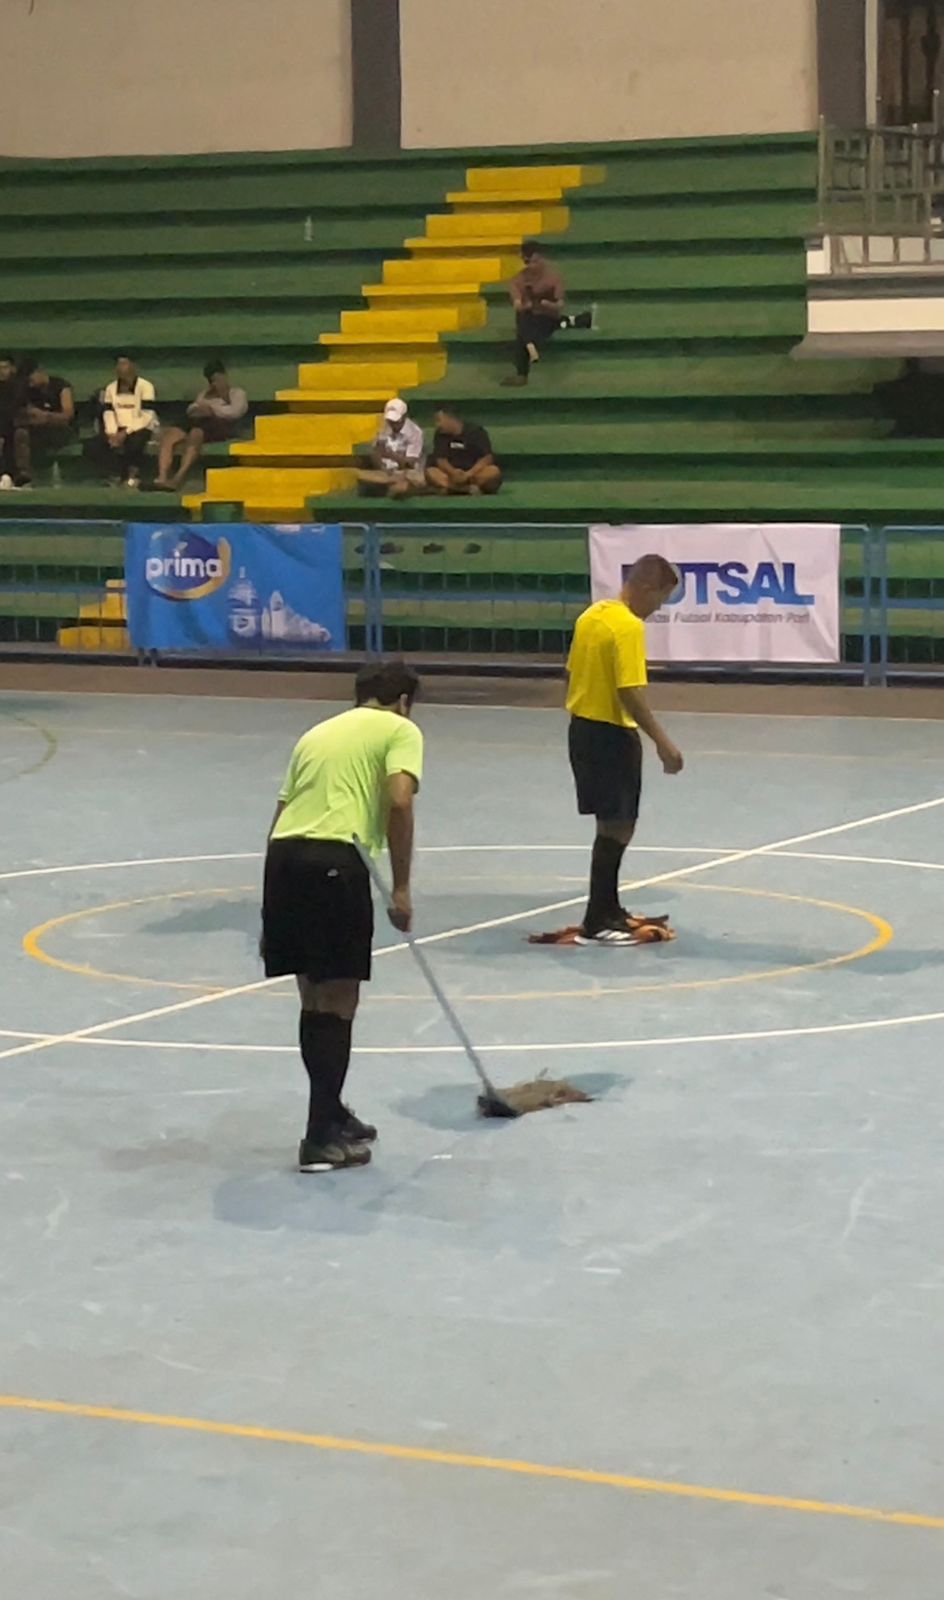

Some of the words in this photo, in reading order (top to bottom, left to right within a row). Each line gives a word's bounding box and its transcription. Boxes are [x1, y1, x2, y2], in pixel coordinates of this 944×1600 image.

[146, 551, 223, 582] prima
[622, 562, 815, 605] TSAL
[673, 611, 712, 624] Futsal
[714, 611, 782, 626] Kabupaten
